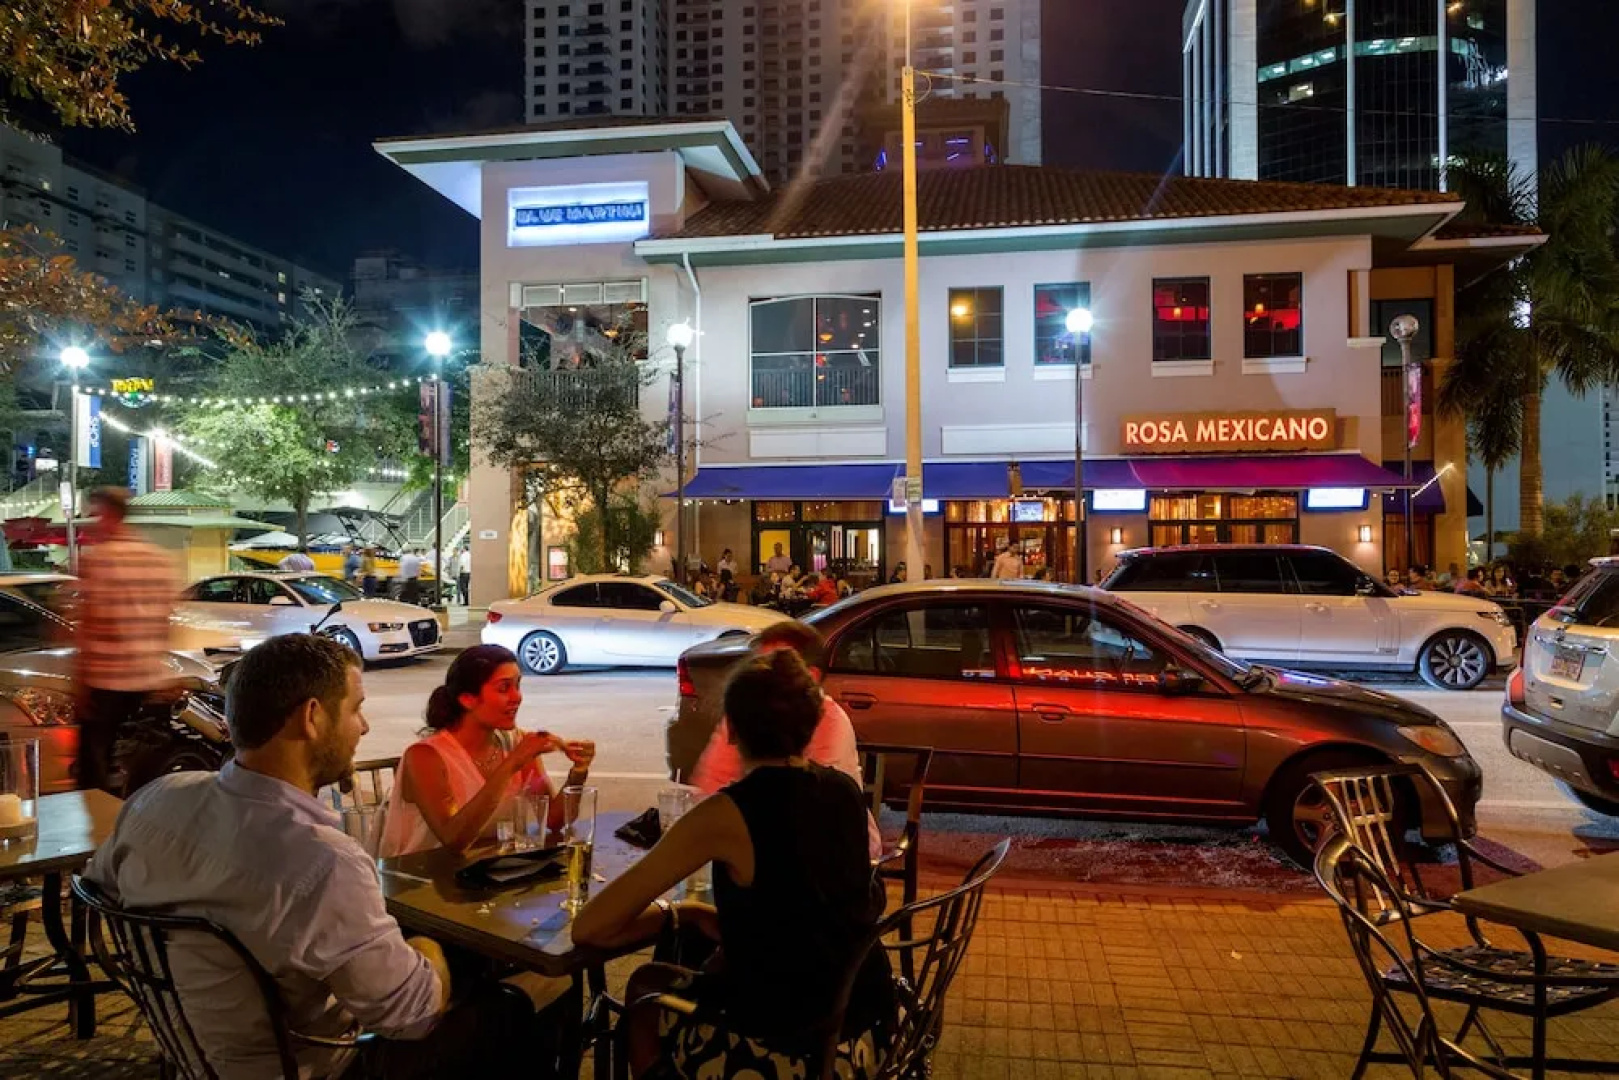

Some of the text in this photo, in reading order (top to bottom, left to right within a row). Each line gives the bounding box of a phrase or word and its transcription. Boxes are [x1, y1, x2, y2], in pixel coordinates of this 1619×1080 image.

[517, 207, 563, 224] BLUE
[1126, 417, 1328, 444] ROSA MEXICANO
